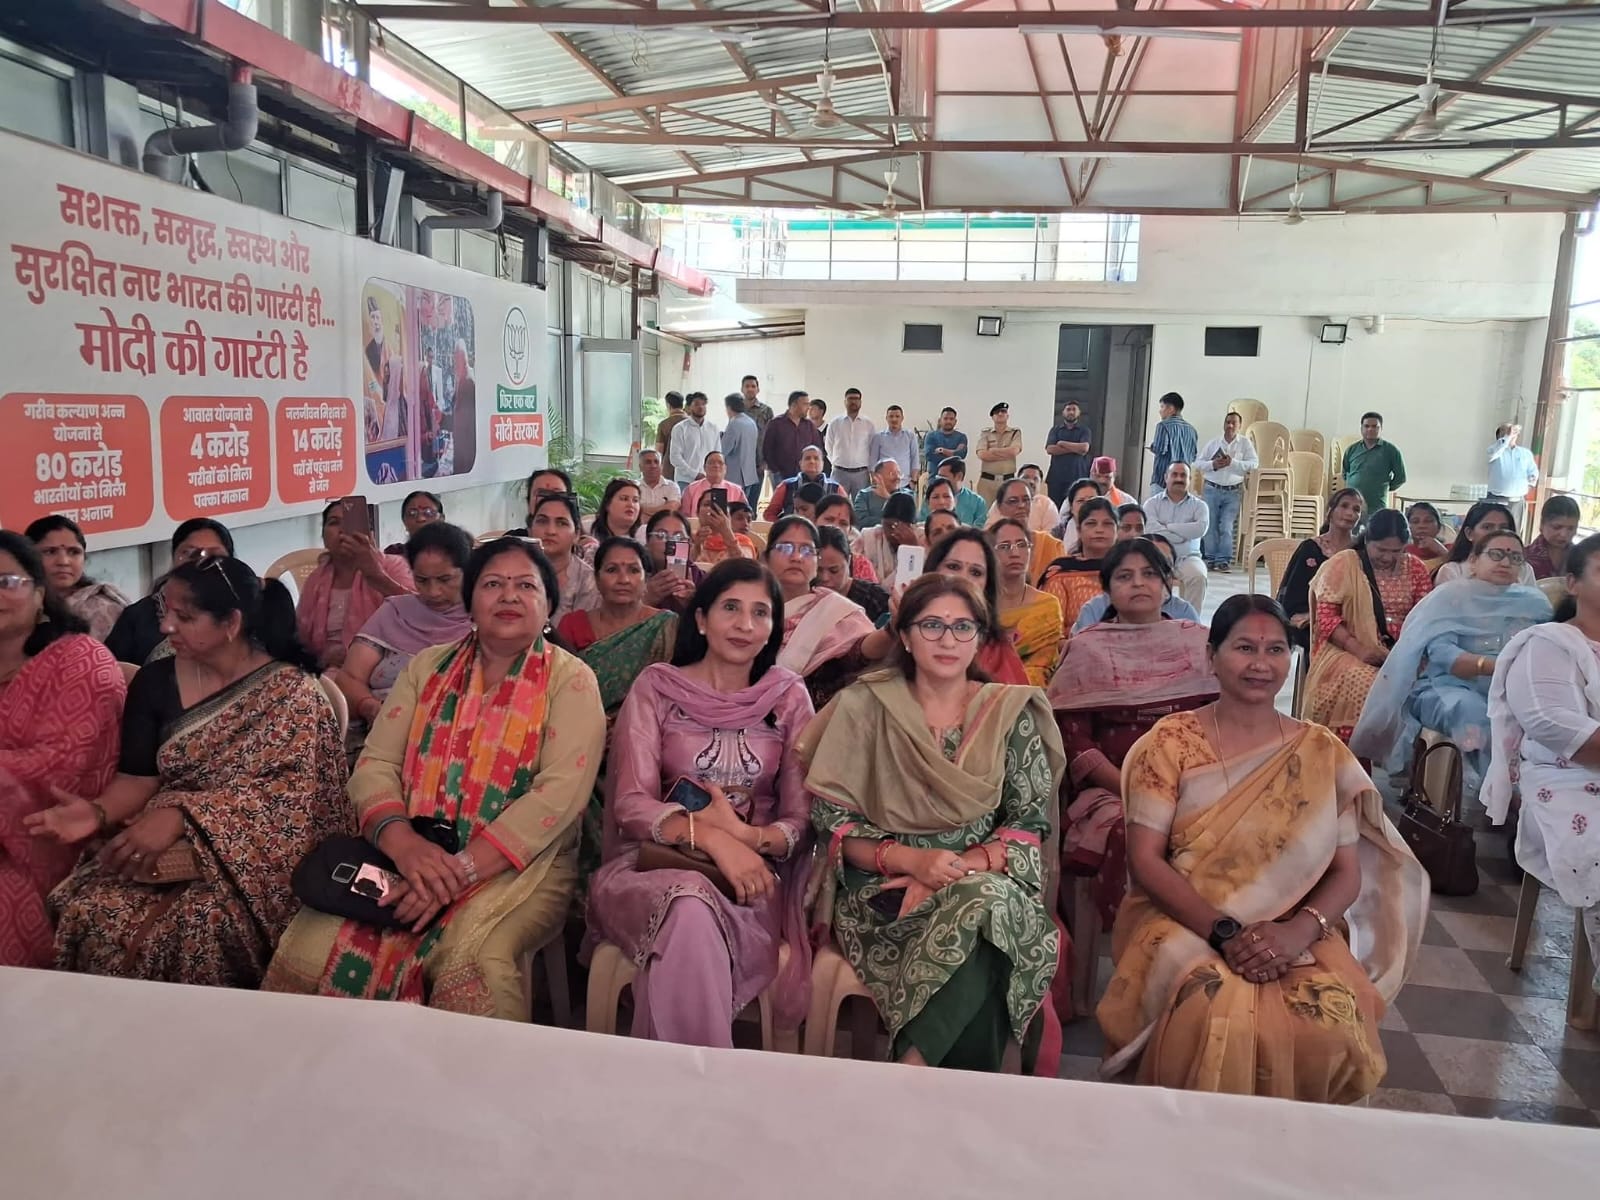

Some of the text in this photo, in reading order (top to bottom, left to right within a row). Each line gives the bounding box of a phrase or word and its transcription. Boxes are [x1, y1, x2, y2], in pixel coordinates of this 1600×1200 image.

[56, 183, 310, 274] सशक्त, समृद्ध, स्वस्थ और
[11, 240, 116, 305] सुरक्षित
[120, 263, 161, 302] नए
[167, 272, 222, 313] भारत
[225, 273, 252, 316] की
[255, 283, 304, 322] गारंटी
[74, 306, 309, 381] मोदी की गारंटी है
[24, 398, 125, 419] गरीब कल्याण अन्न
[183, 403, 253, 423] आवास योजना से
[53, 422, 103, 441] योजना से
[293, 420, 343, 456] 14 करोड़
[495, 416, 540, 442] मोदी सरकार
[190, 423, 249, 465] 4 करोड़
[36, 442, 122, 482] 80 करोड़
[187, 463, 252, 486] गरीबों को मिला
[34, 482, 81, 504] भारतीयों
[81, 481, 97, 499] को
[193, 488, 249, 508] पक्का मकान
[81, 505, 114, 521] अनाज
